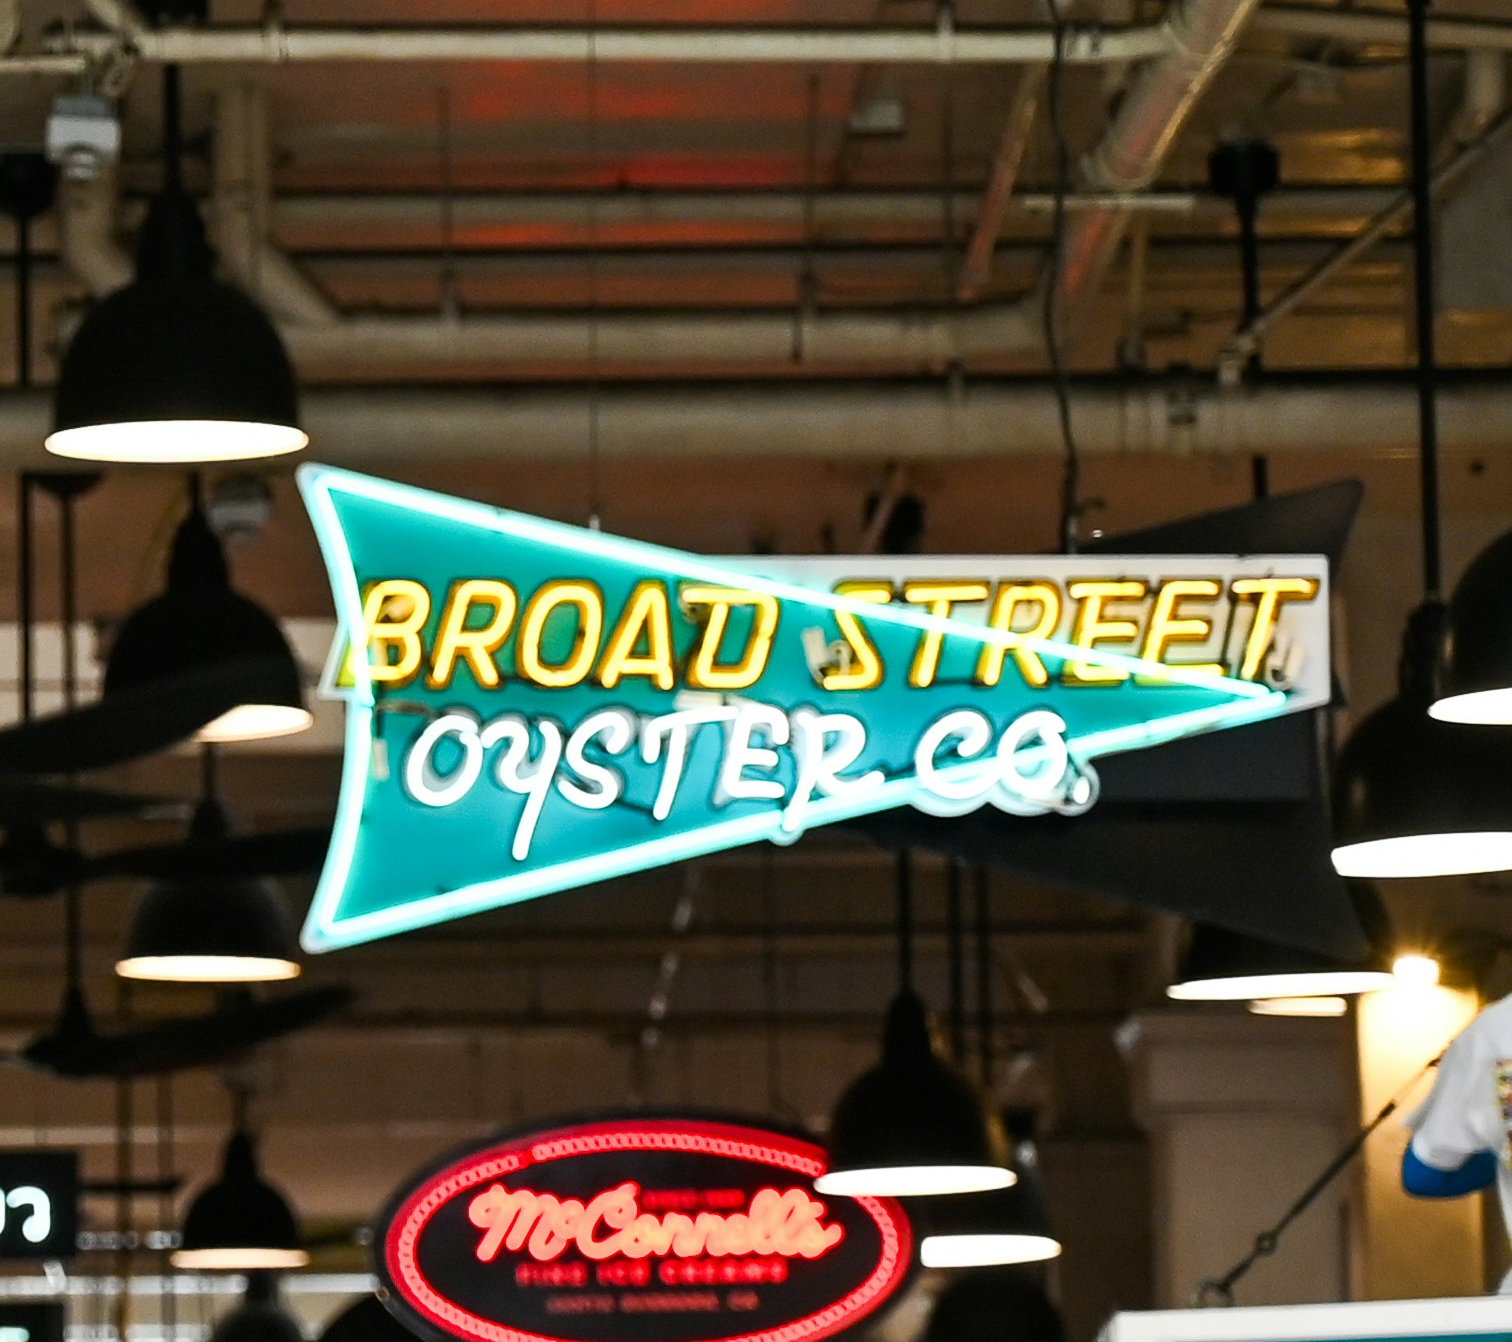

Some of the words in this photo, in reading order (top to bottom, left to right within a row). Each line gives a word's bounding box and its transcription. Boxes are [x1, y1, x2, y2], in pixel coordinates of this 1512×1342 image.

[338, 577, 780, 692] BROAD
[816, 575, 1321, 692] STREET
[404, 701, 884, 863] OYSTER
[914, 706, 1095, 808] CO.
